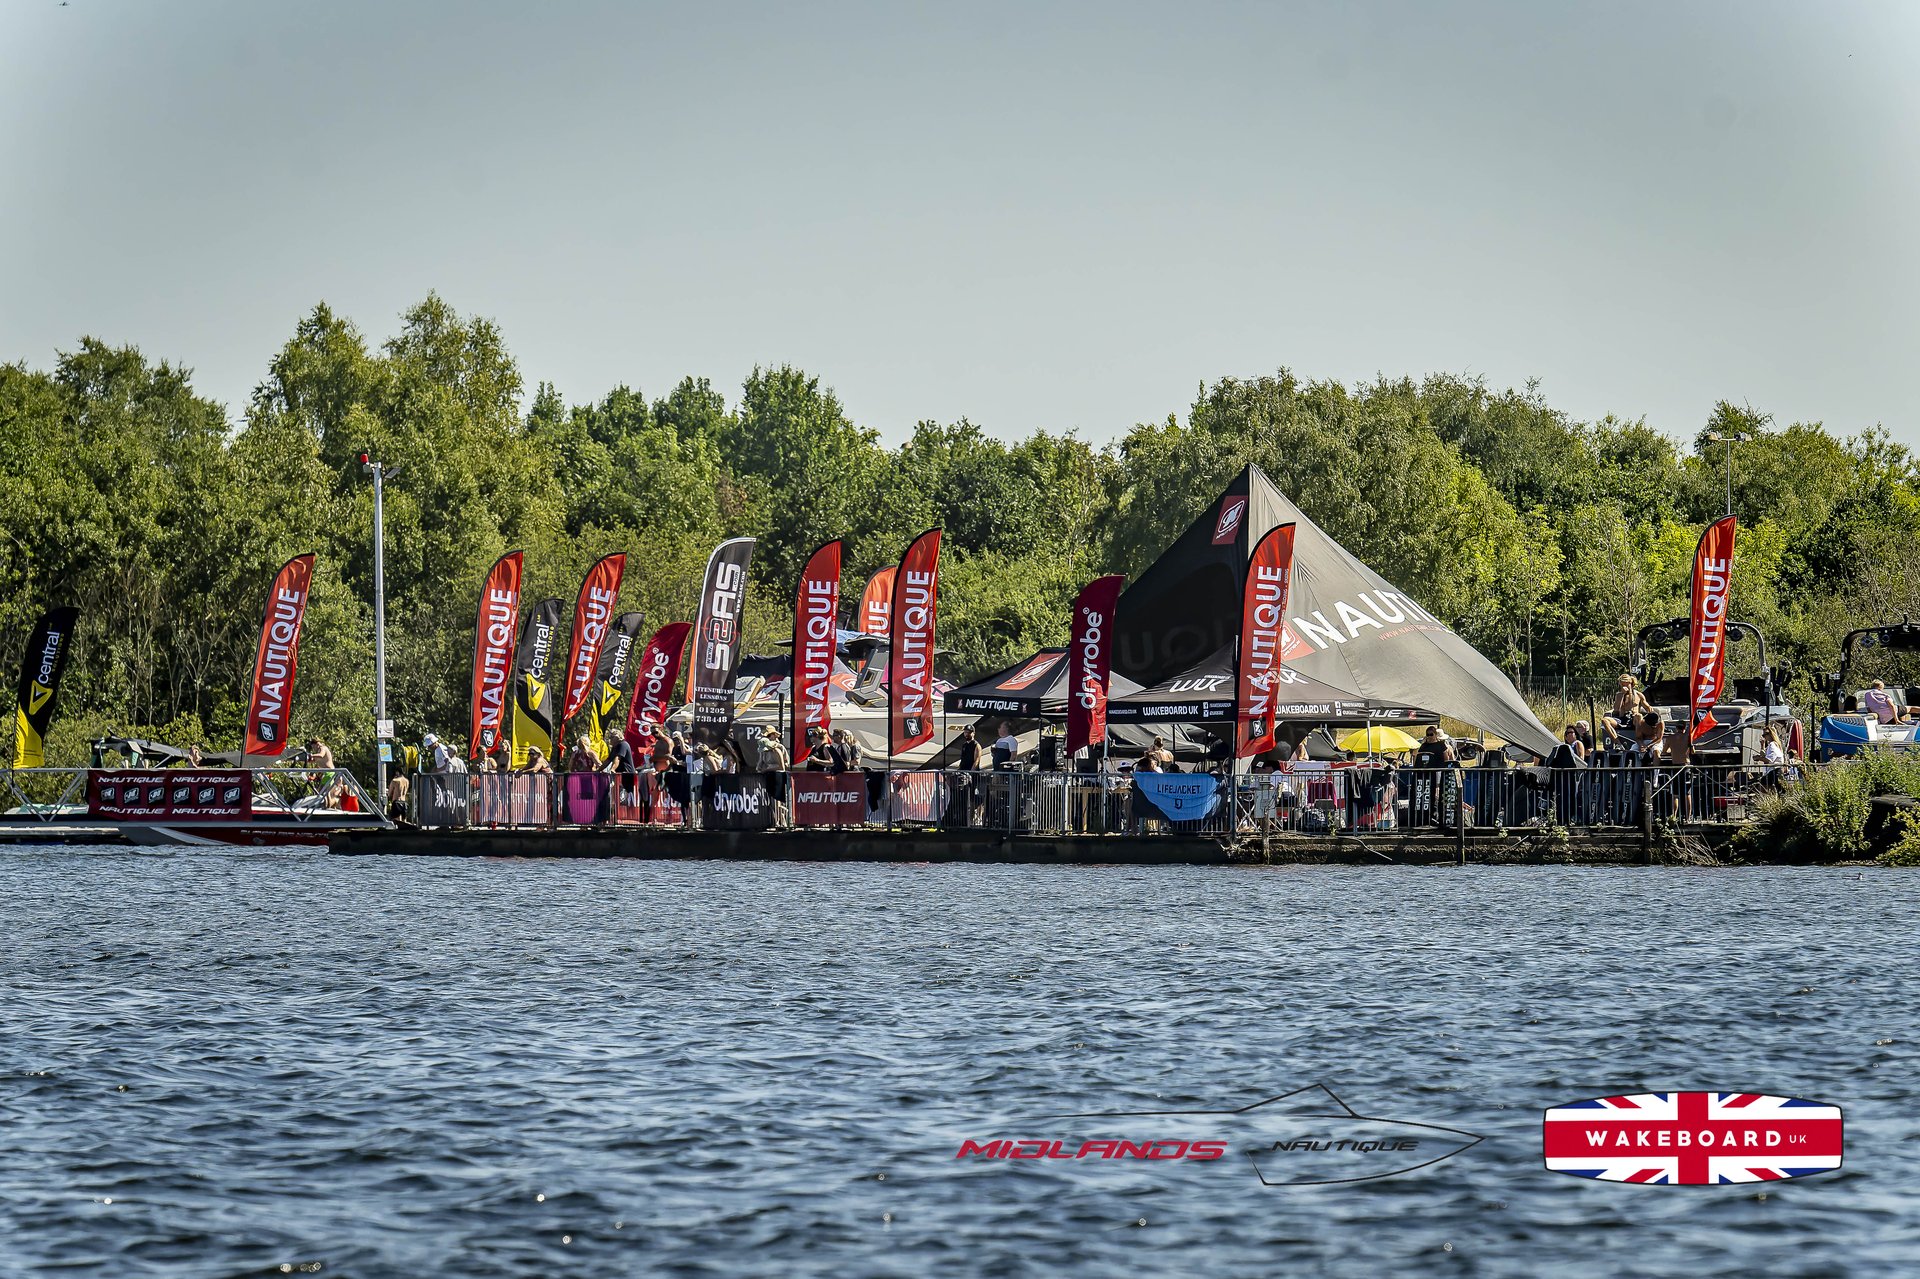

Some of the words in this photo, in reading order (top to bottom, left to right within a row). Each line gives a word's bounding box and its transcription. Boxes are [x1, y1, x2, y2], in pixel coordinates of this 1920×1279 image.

[903, 570, 930, 713] NAUTIQUE
[1249, 566, 1282, 715] NAUTIQUE
[1292, 589, 1452, 650] NAUTI
[1697, 558, 1726, 704] NAUTIQUE
[38, 631, 60, 684] central
[258, 587, 300, 720] NAUTIQUE
[480, 588, 512, 726] NAUTIQUE
[531, 623, 549, 678] central
[608, 634, 631, 685] central
[805, 580, 832, 723] NAUTIQUE
[698, 706, 725, 714] 01202
[965, 698, 1020, 711] NAUTIQUE
[1142, 705, 1187, 716] WAKEBOARD
[1188, 705, 1199, 715] UK
[1320, 704, 1331, 714] UK
[98, 805, 166, 815] NAUTIQUE
[797, 791, 860, 805] NAUTIQUE
